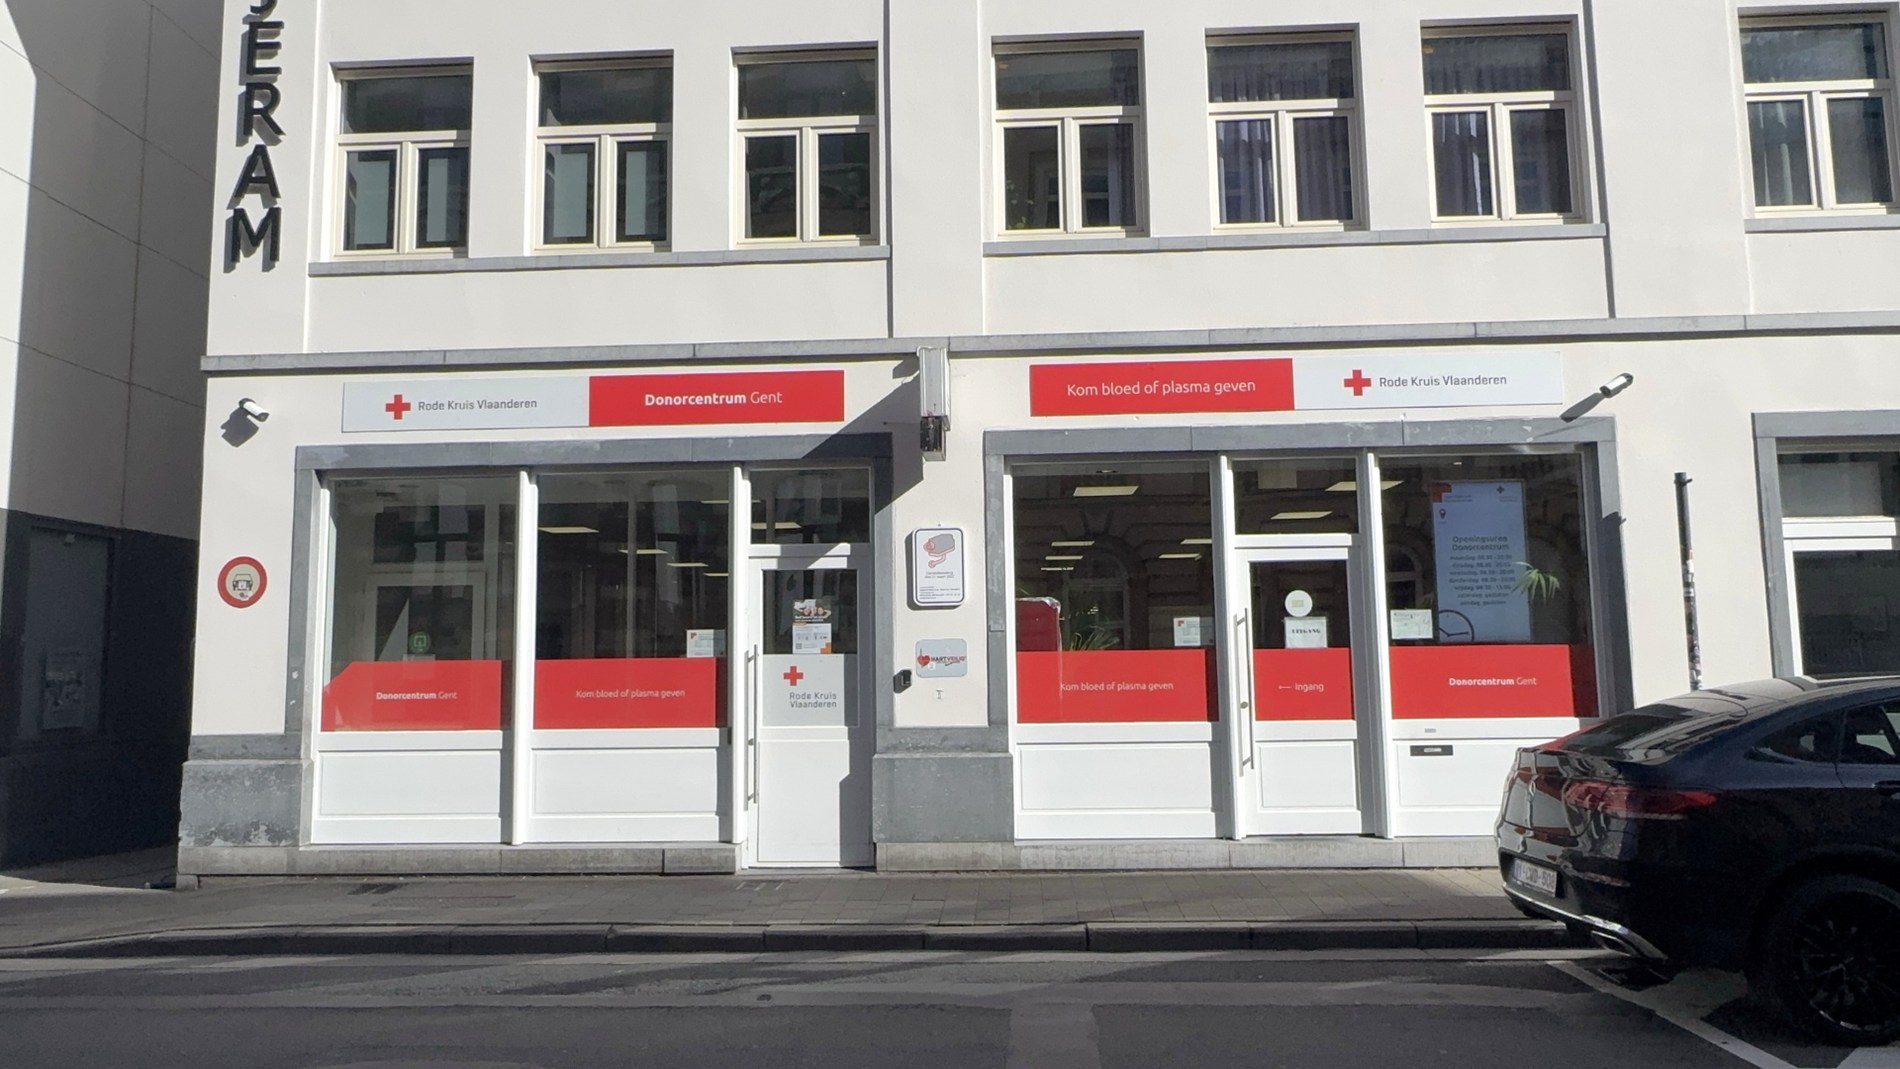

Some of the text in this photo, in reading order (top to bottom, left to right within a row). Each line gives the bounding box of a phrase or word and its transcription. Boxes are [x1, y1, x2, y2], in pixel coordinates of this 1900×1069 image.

[231, 0, 286, 263] ERAM
[1379, 375, 1507, 387] Rode Kruis Vlaanderen
[1067, 380, 1256, 396] Kom bloed of plasma geven
[645, 391, 783, 406] Donorcentrum Gent
[418, 399, 538, 411] Rode Kruis Vlaanderen
[1452, 535, 1508, 544] Openingsuren
[1060, 681, 1174, 692] Kom bloed of plasma geven
[1449, 677, 1537, 686] Donorcentrum Gent
[376, 691, 458, 700] Donorcentrum Gent
[575, 689, 686, 699] Kom bloed of plasma geven
[789, 691, 837, 700] Rode Kruis
[789, 700, 837, 709] Vlaanderen
